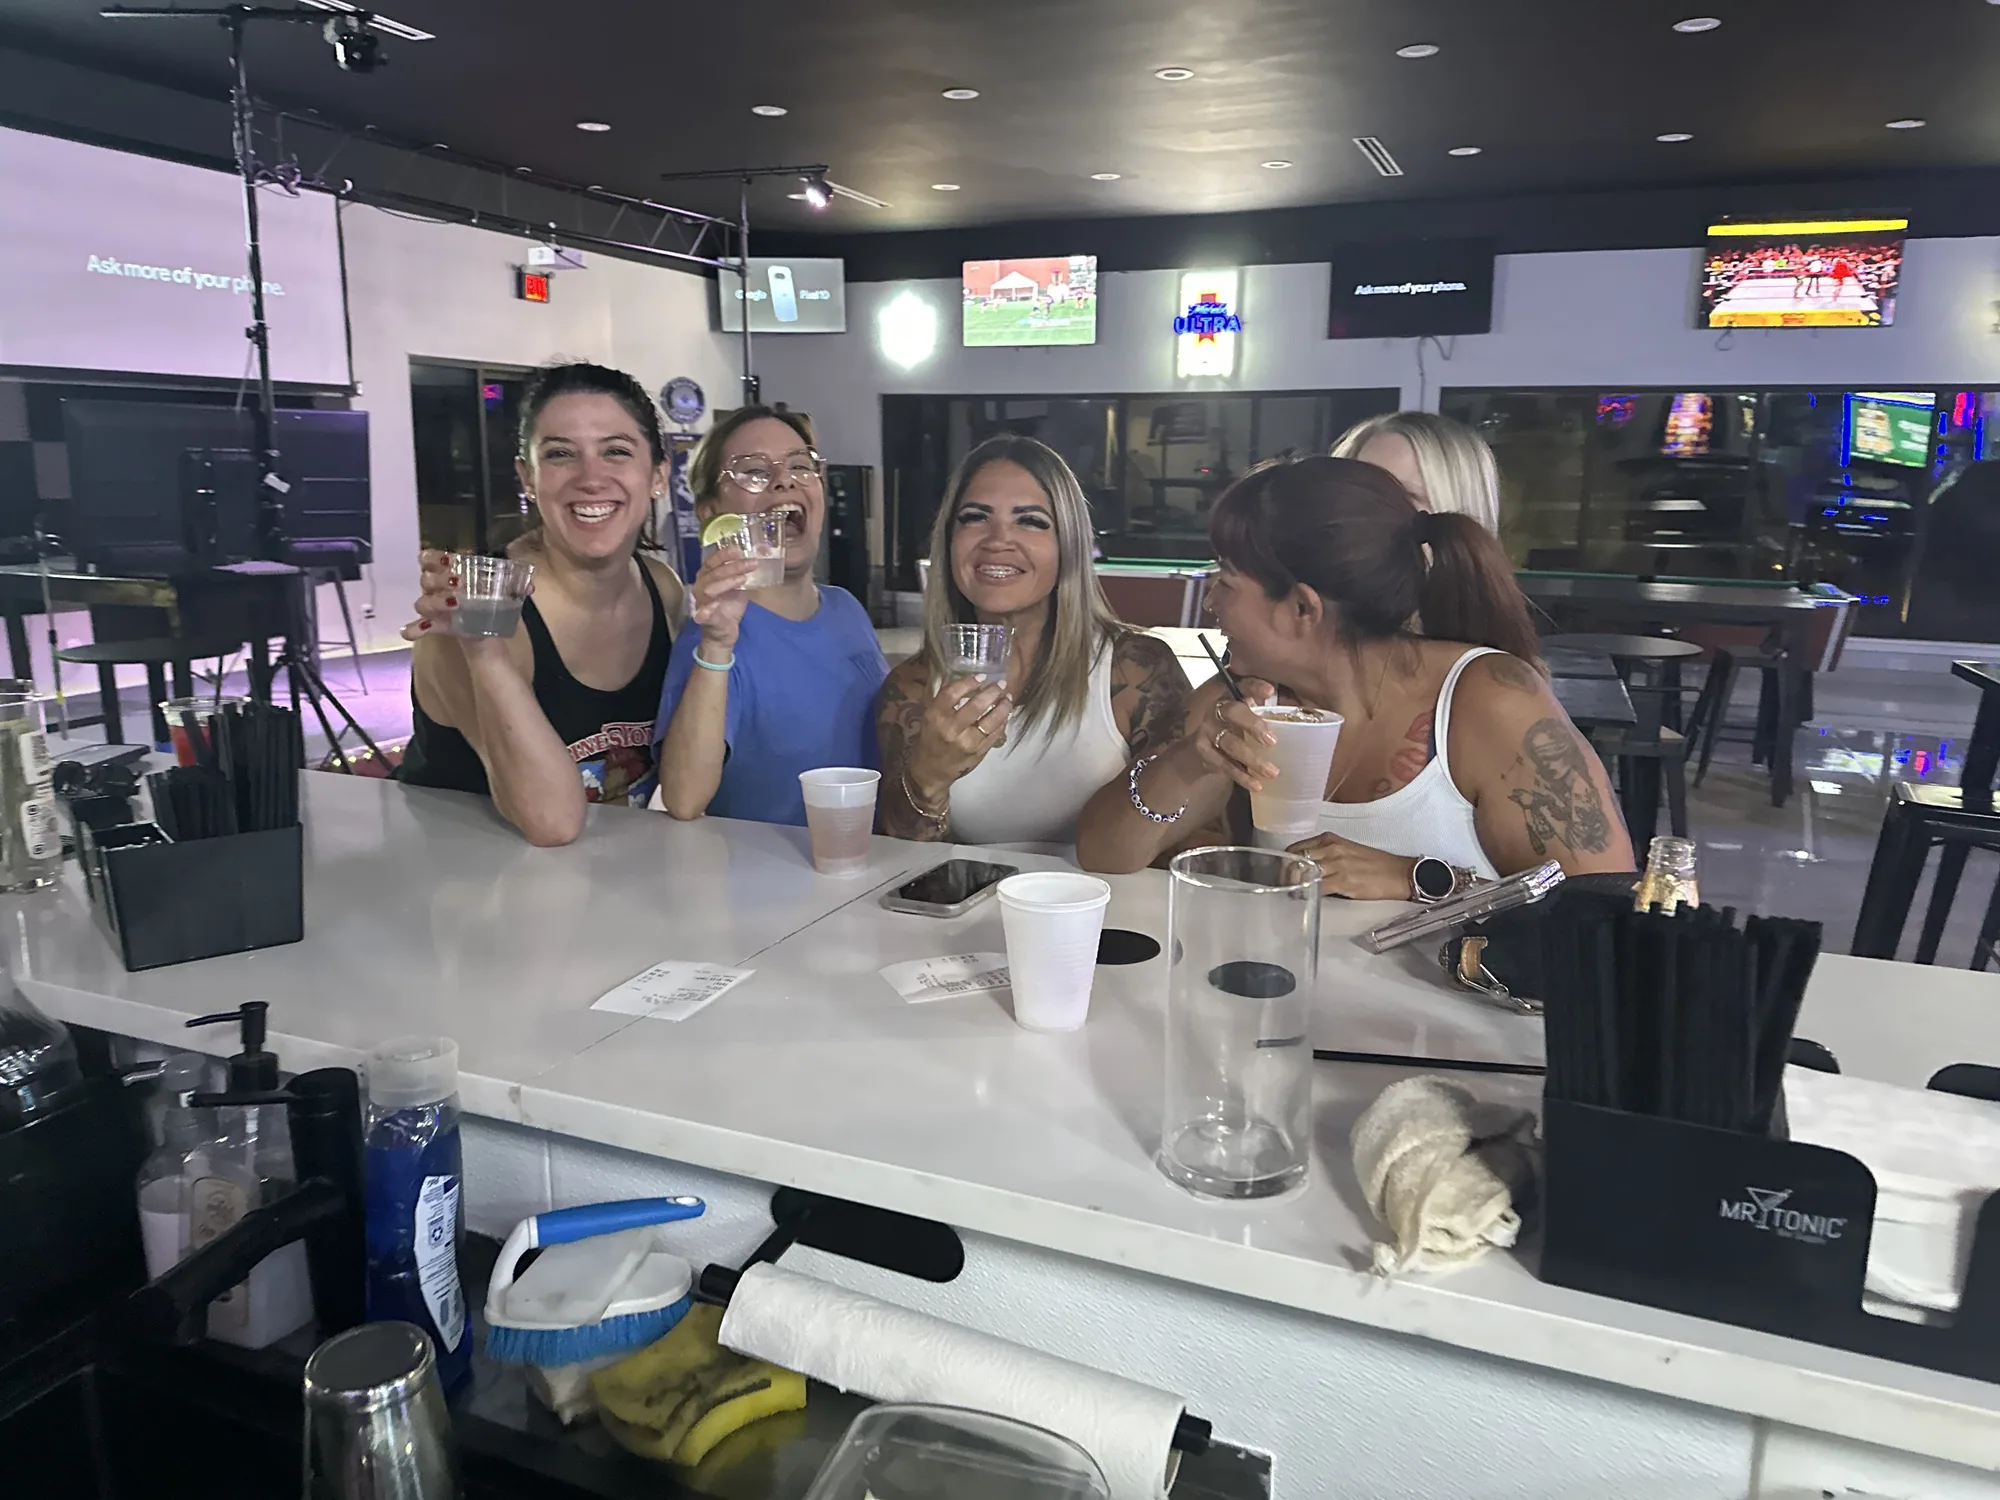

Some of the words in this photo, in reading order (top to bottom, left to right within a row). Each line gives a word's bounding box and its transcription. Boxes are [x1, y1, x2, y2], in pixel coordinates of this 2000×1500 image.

[86, 254, 123, 276] Ask
[124, 262, 171, 281] more
[172, 266, 193, 284] of
[193, 272, 231, 290] your
[232, 274, 286, 296] phne.
[1399, 282, 1412, 293] of
[1410, 284, 1433, 295] your
[1173, 314, 1241, 335] ULTRA
[1719, 1198, 1757, 1223] MR
[1773, 1207, 1842, 1239] TONIC
